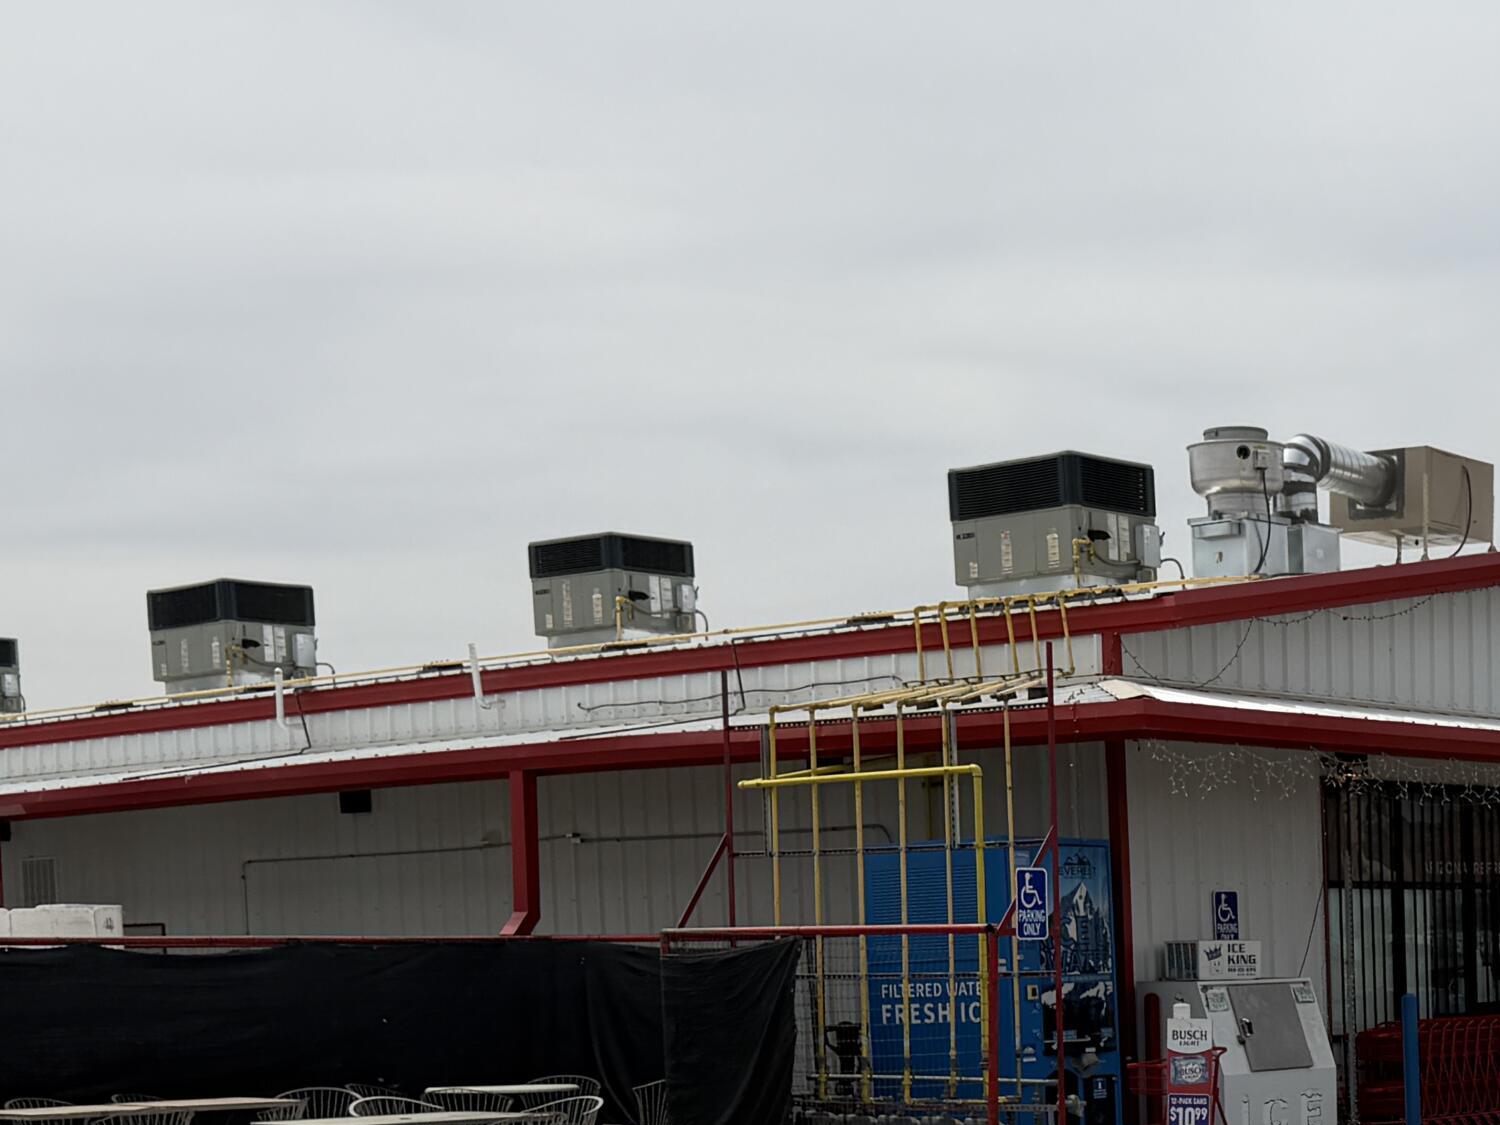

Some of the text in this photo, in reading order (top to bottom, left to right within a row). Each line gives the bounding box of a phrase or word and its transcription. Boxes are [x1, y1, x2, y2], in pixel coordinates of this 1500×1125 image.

[1019, 909, 1046, 923] PARKING
[1023, 923, 1041, 936] ONLY
[1227, 943, 1246, 953] ICE
[1227, 954, 1256, 965] KING
[946, 981, 982, 997] WATE
[882, 1002, 981, 1024] FRESH IC
[1172, 1029, 1208, 1041] BUSCH
